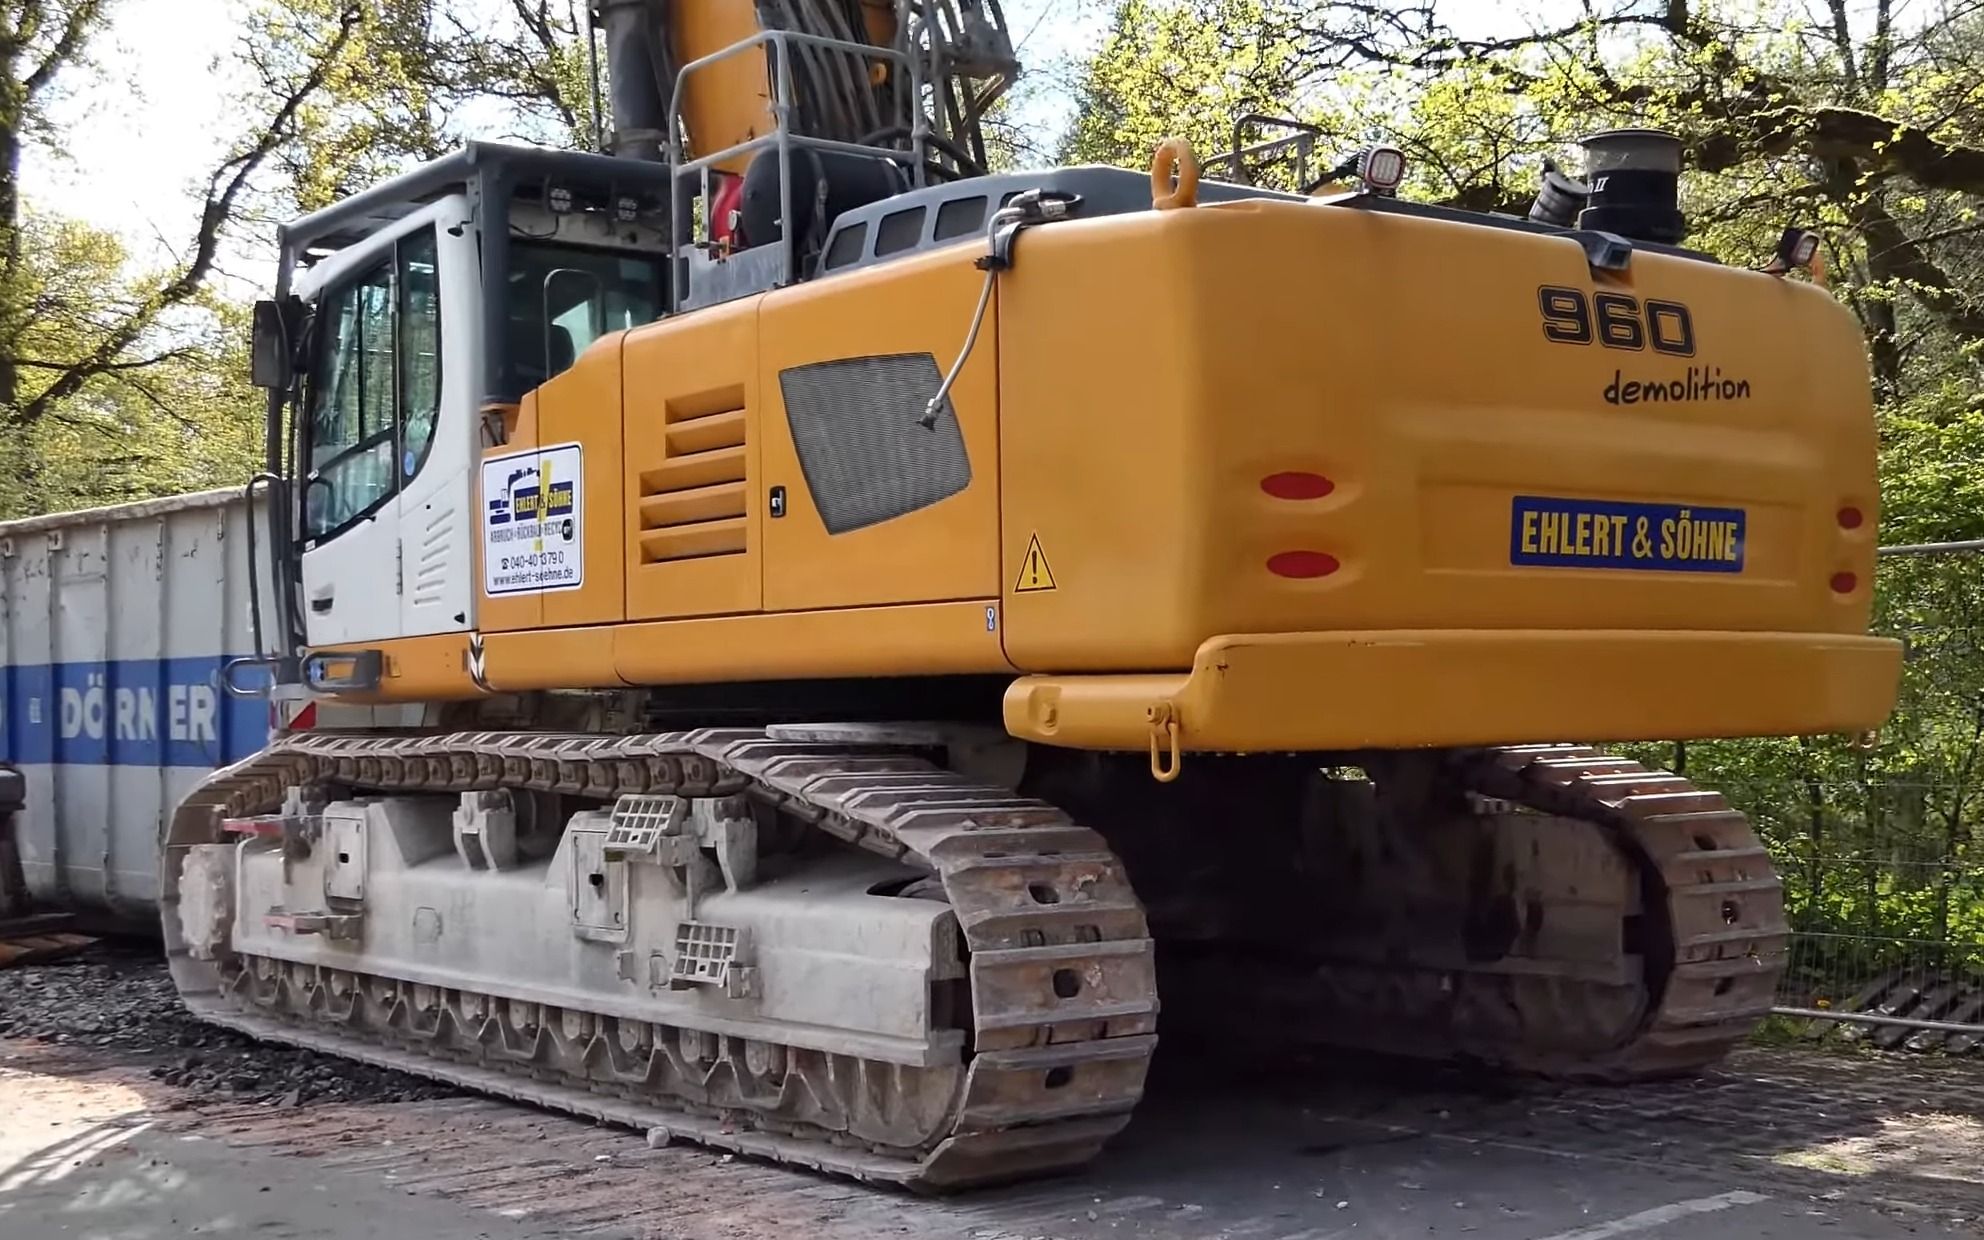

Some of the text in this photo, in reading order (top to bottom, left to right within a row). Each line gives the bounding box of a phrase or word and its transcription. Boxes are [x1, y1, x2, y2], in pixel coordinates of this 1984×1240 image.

[1537, 284, 1697, 358] 960
[1603, 365, 1751, 405] demolition
[1520, 509, 1738, 561] EHLERT & SÖHNE
[61, 673, 216, 741] DÖRNER
